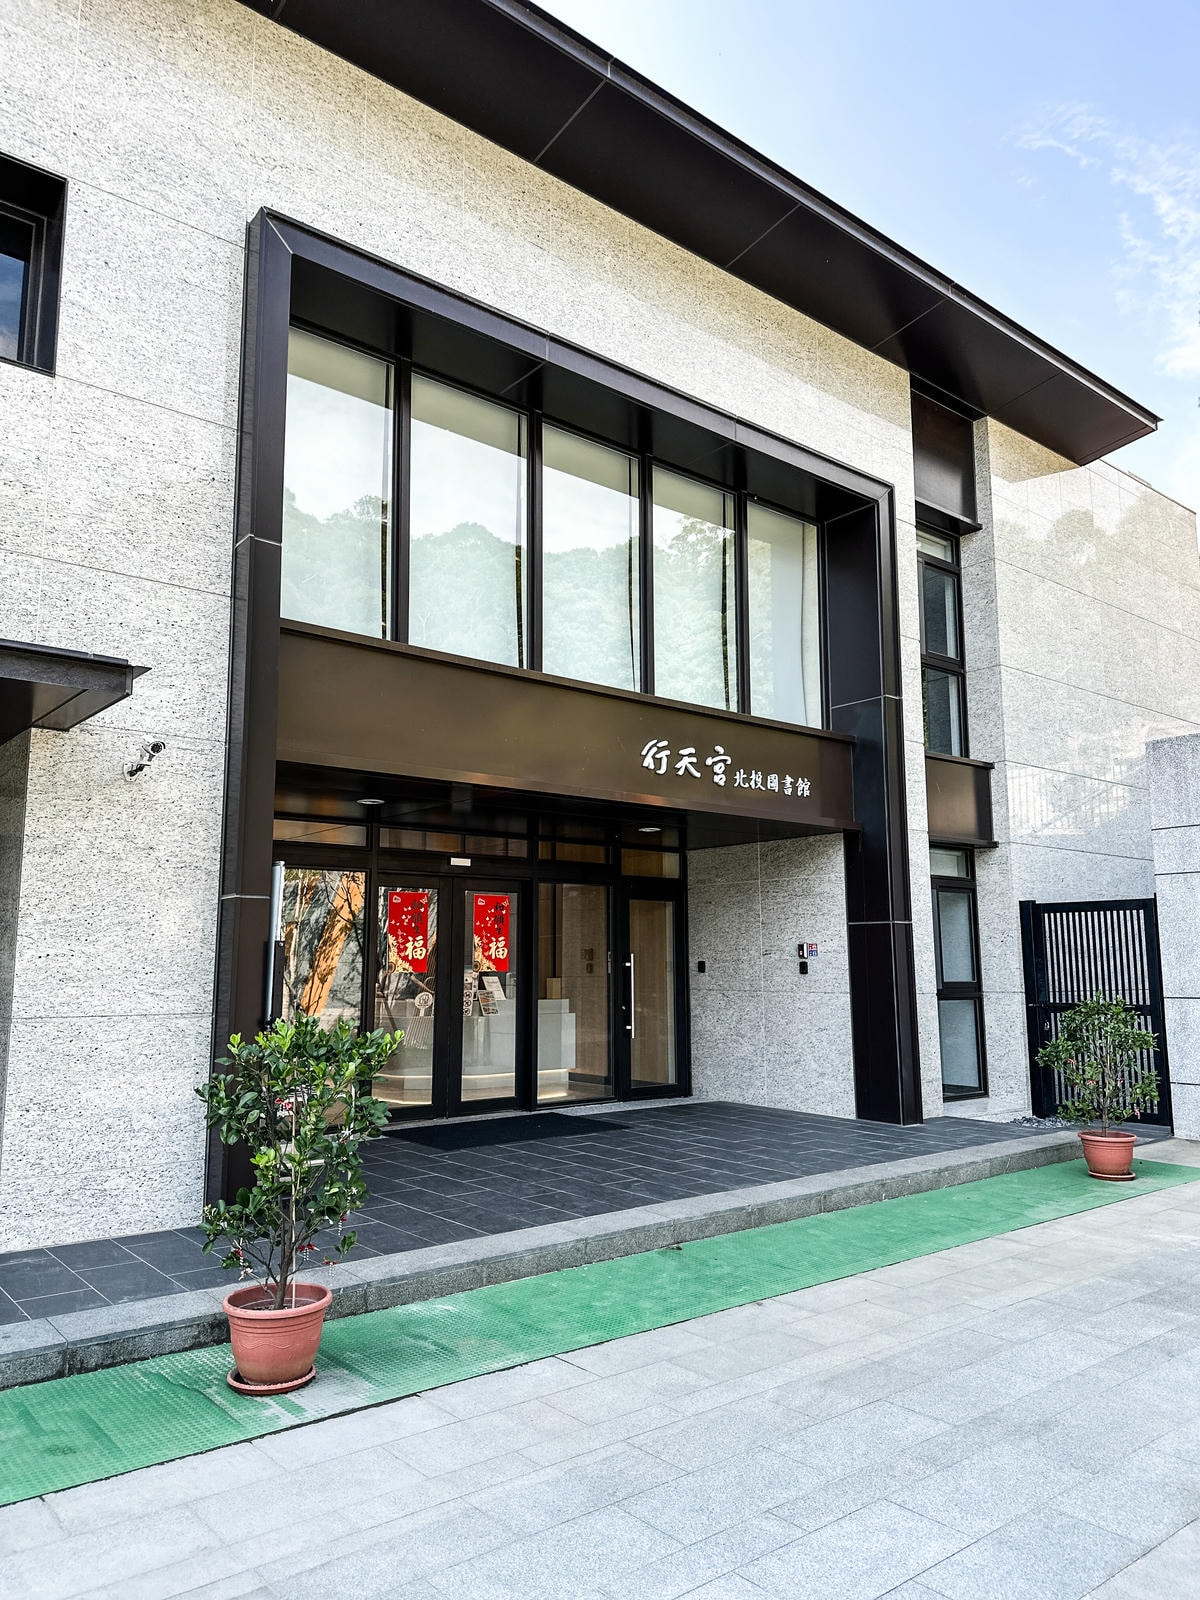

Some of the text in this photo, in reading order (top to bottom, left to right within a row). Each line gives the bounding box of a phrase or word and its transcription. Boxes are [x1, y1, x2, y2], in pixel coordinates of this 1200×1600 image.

[641, 739, 811, 797] 行天宮 北投圖書館
[405, 936, 427, 960] 福
[489, 936, 508, 959] 福
